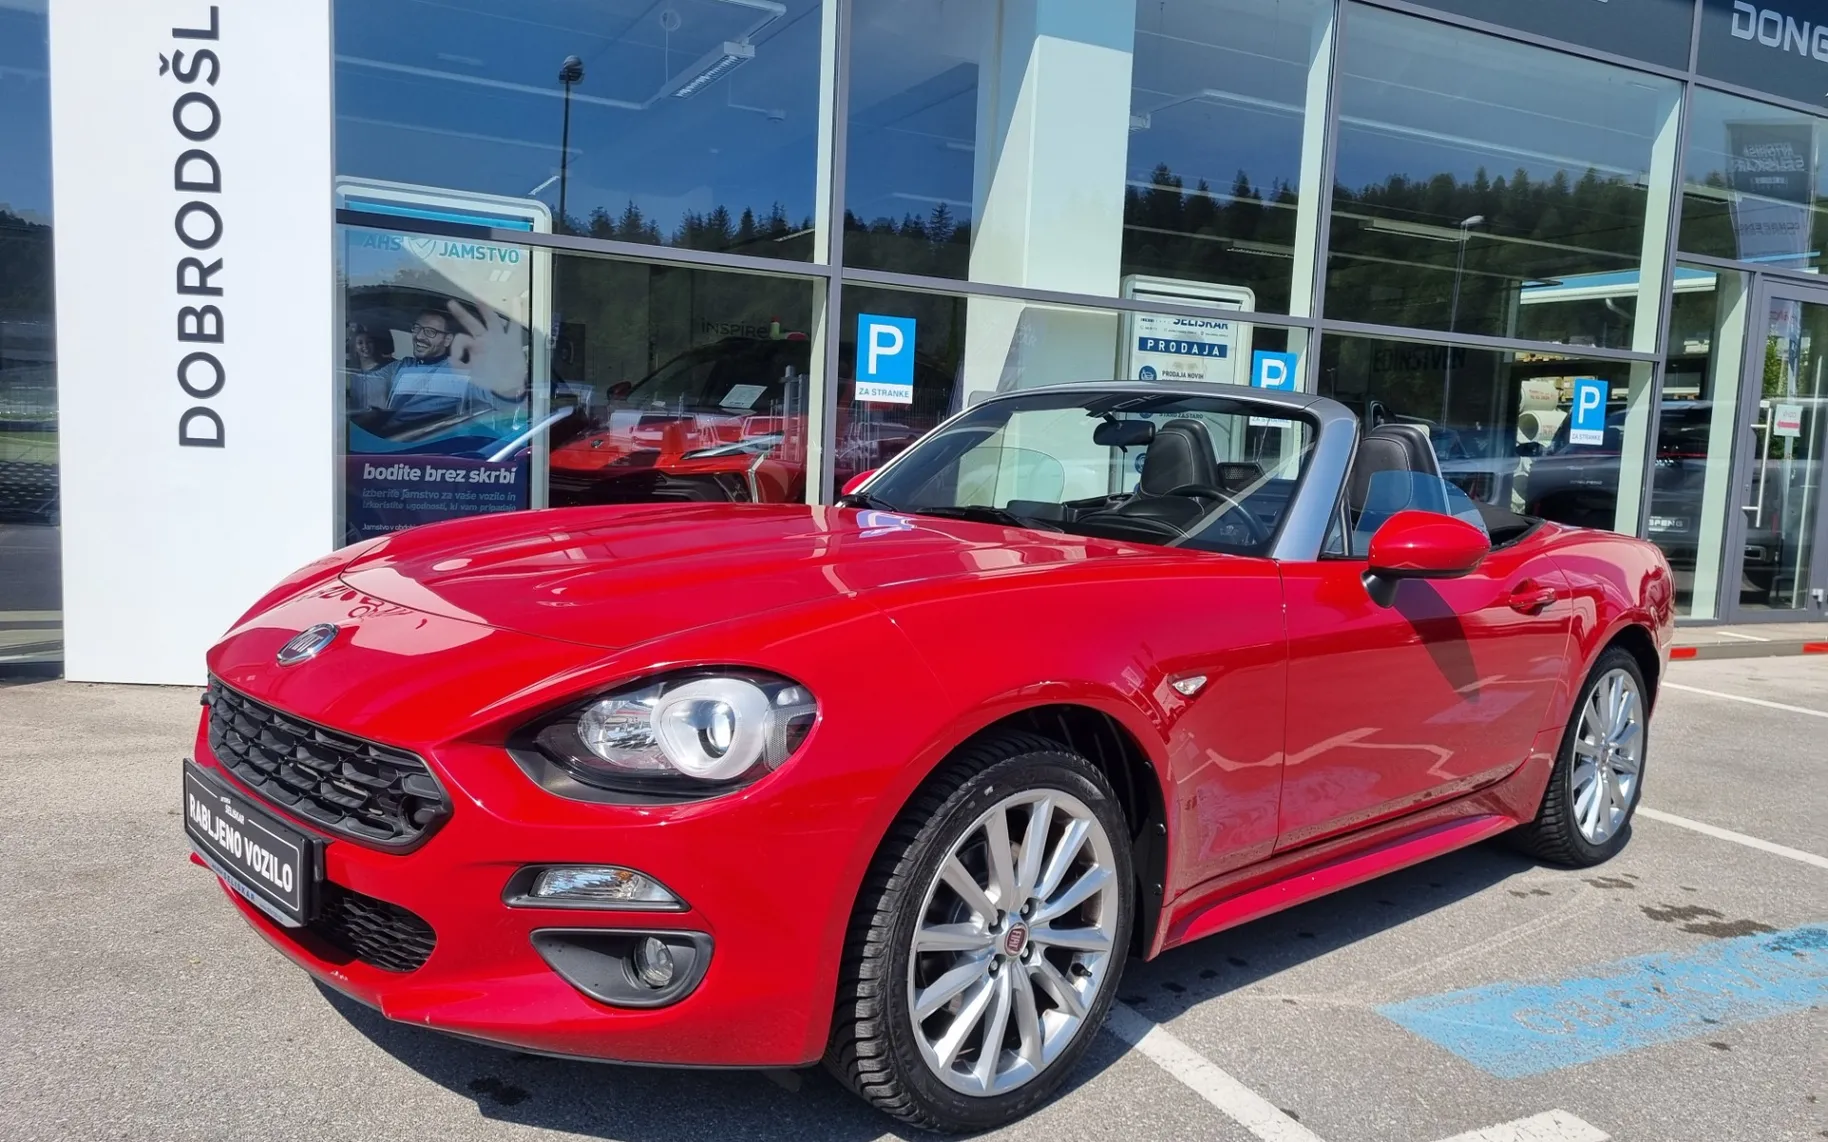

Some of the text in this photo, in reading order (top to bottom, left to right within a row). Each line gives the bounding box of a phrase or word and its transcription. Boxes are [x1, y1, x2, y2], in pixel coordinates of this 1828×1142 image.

[159, 5, 226, 449] DOBRODOŠL
[363, 234, 520, 264] AHS JAMSTVO
[868, 323, 904, 375] P
[1146, 339, 1220, 356] PRODAJA
[1162, 369, 1204, 380] PRODAJA NOVIH
[1260, 358, 1287, 388] P
[859, 387, 910, 398] ZA STRANKE
[1578, 385, 1601, 424] P
[363, 463, 518, 484] bodite brez skrbi
[401, 488, 440, 500] jamstvo
[441, 491, 452, 500] za
[455, 490, 477, 500] vaše
[479, 491, 505, 502] vozilo
[507, 491, 516, 502] in
[460, 503, 478, 511] vam
[189, 793, 294, 893] RABLJENO VOZILO
